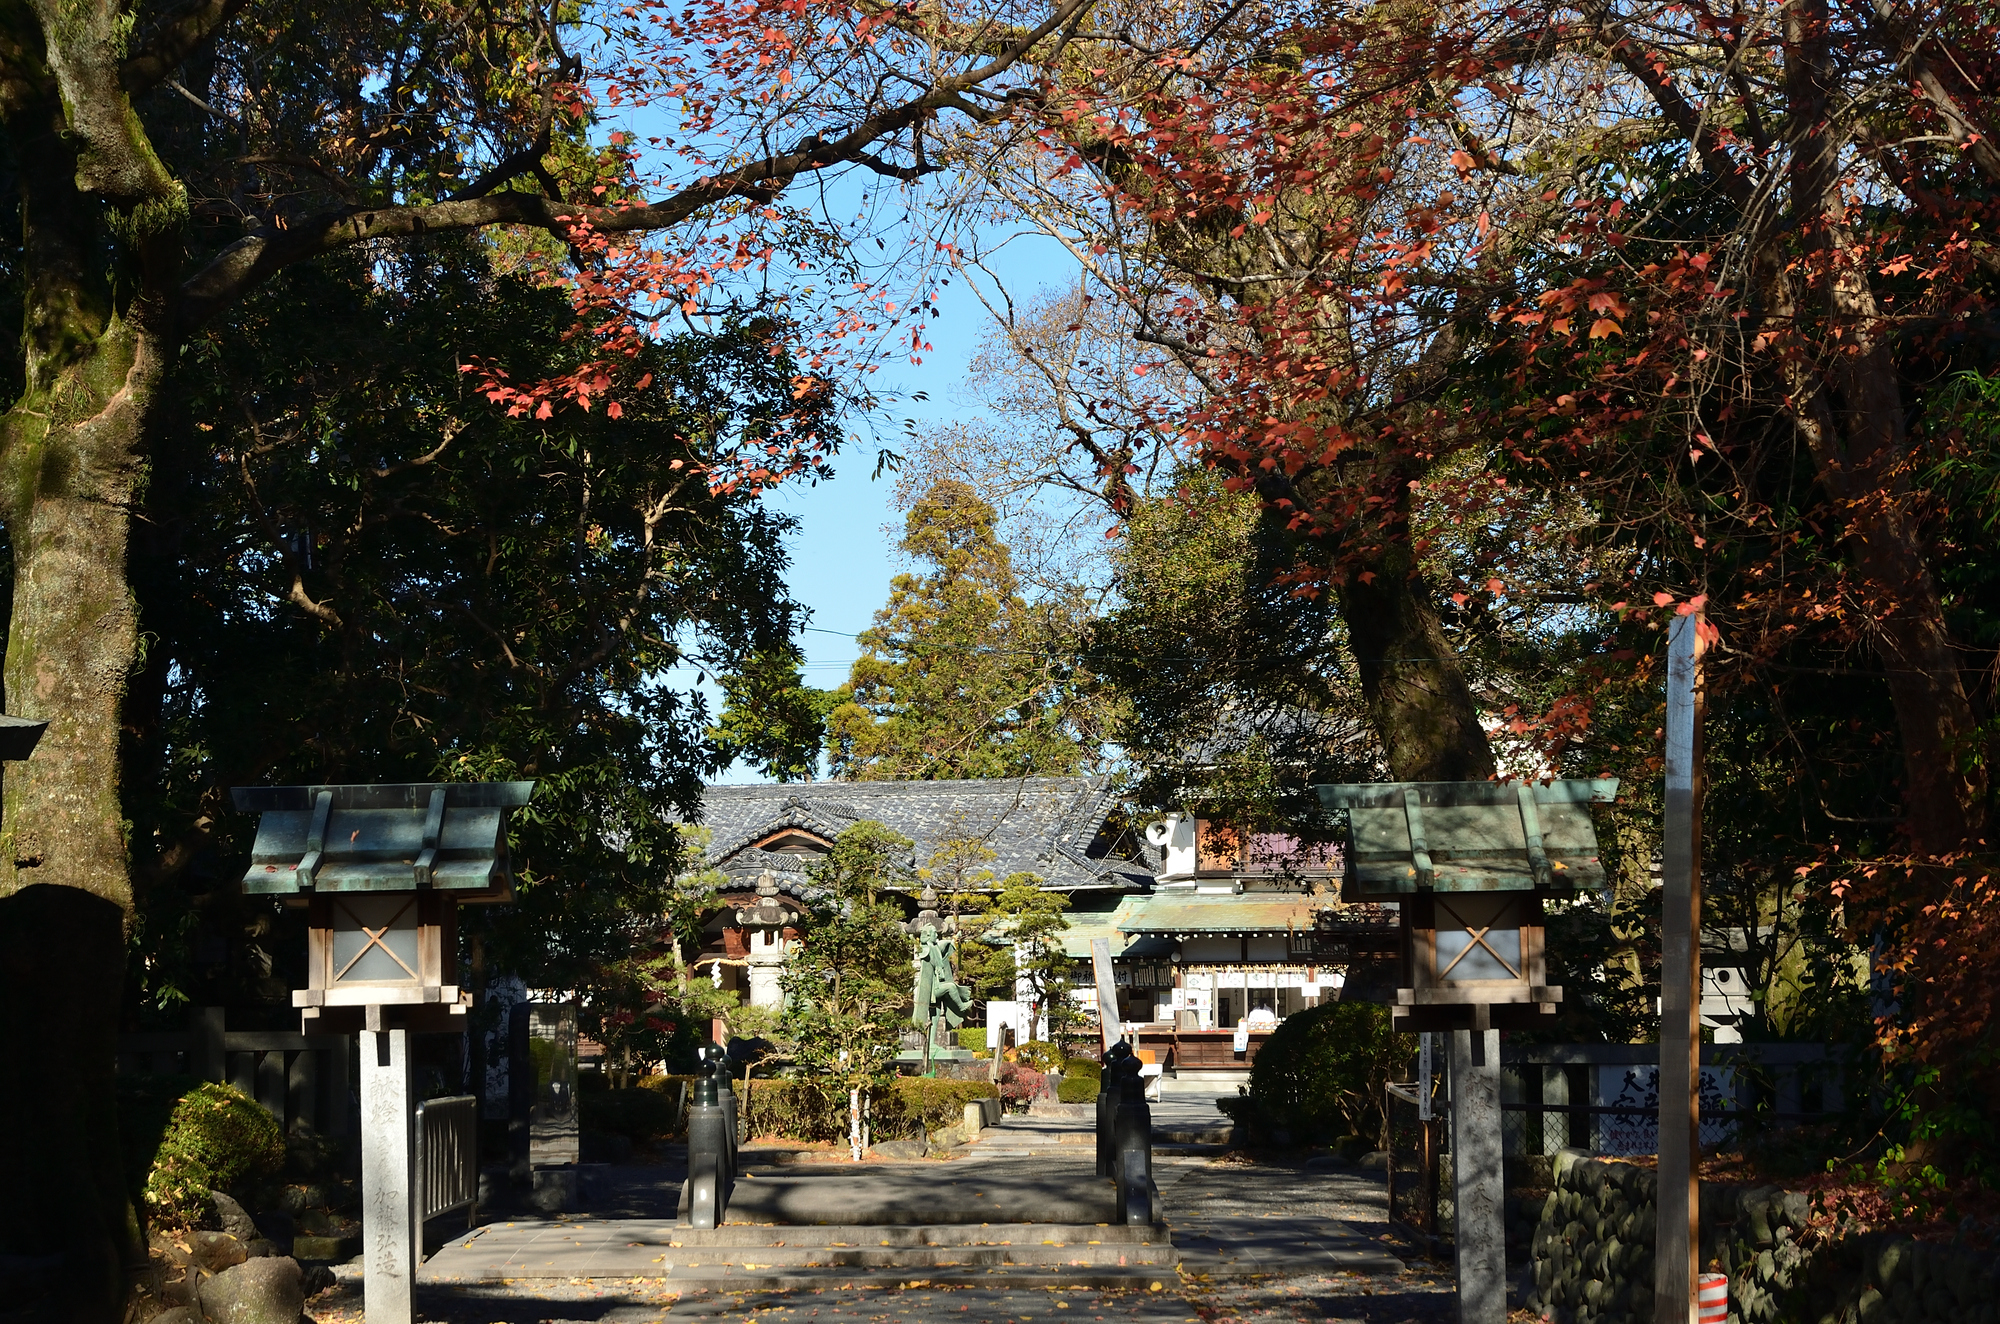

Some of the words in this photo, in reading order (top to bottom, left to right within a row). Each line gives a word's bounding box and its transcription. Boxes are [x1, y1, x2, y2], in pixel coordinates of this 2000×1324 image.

[1070, 970, 1128, 983] 御祈付
[1620, 1069, 1719, 1094] 大井社
[1611, 1093, 1725, 1127] 安産願
[373, 1187, 402, 1279] 加藤弘造
